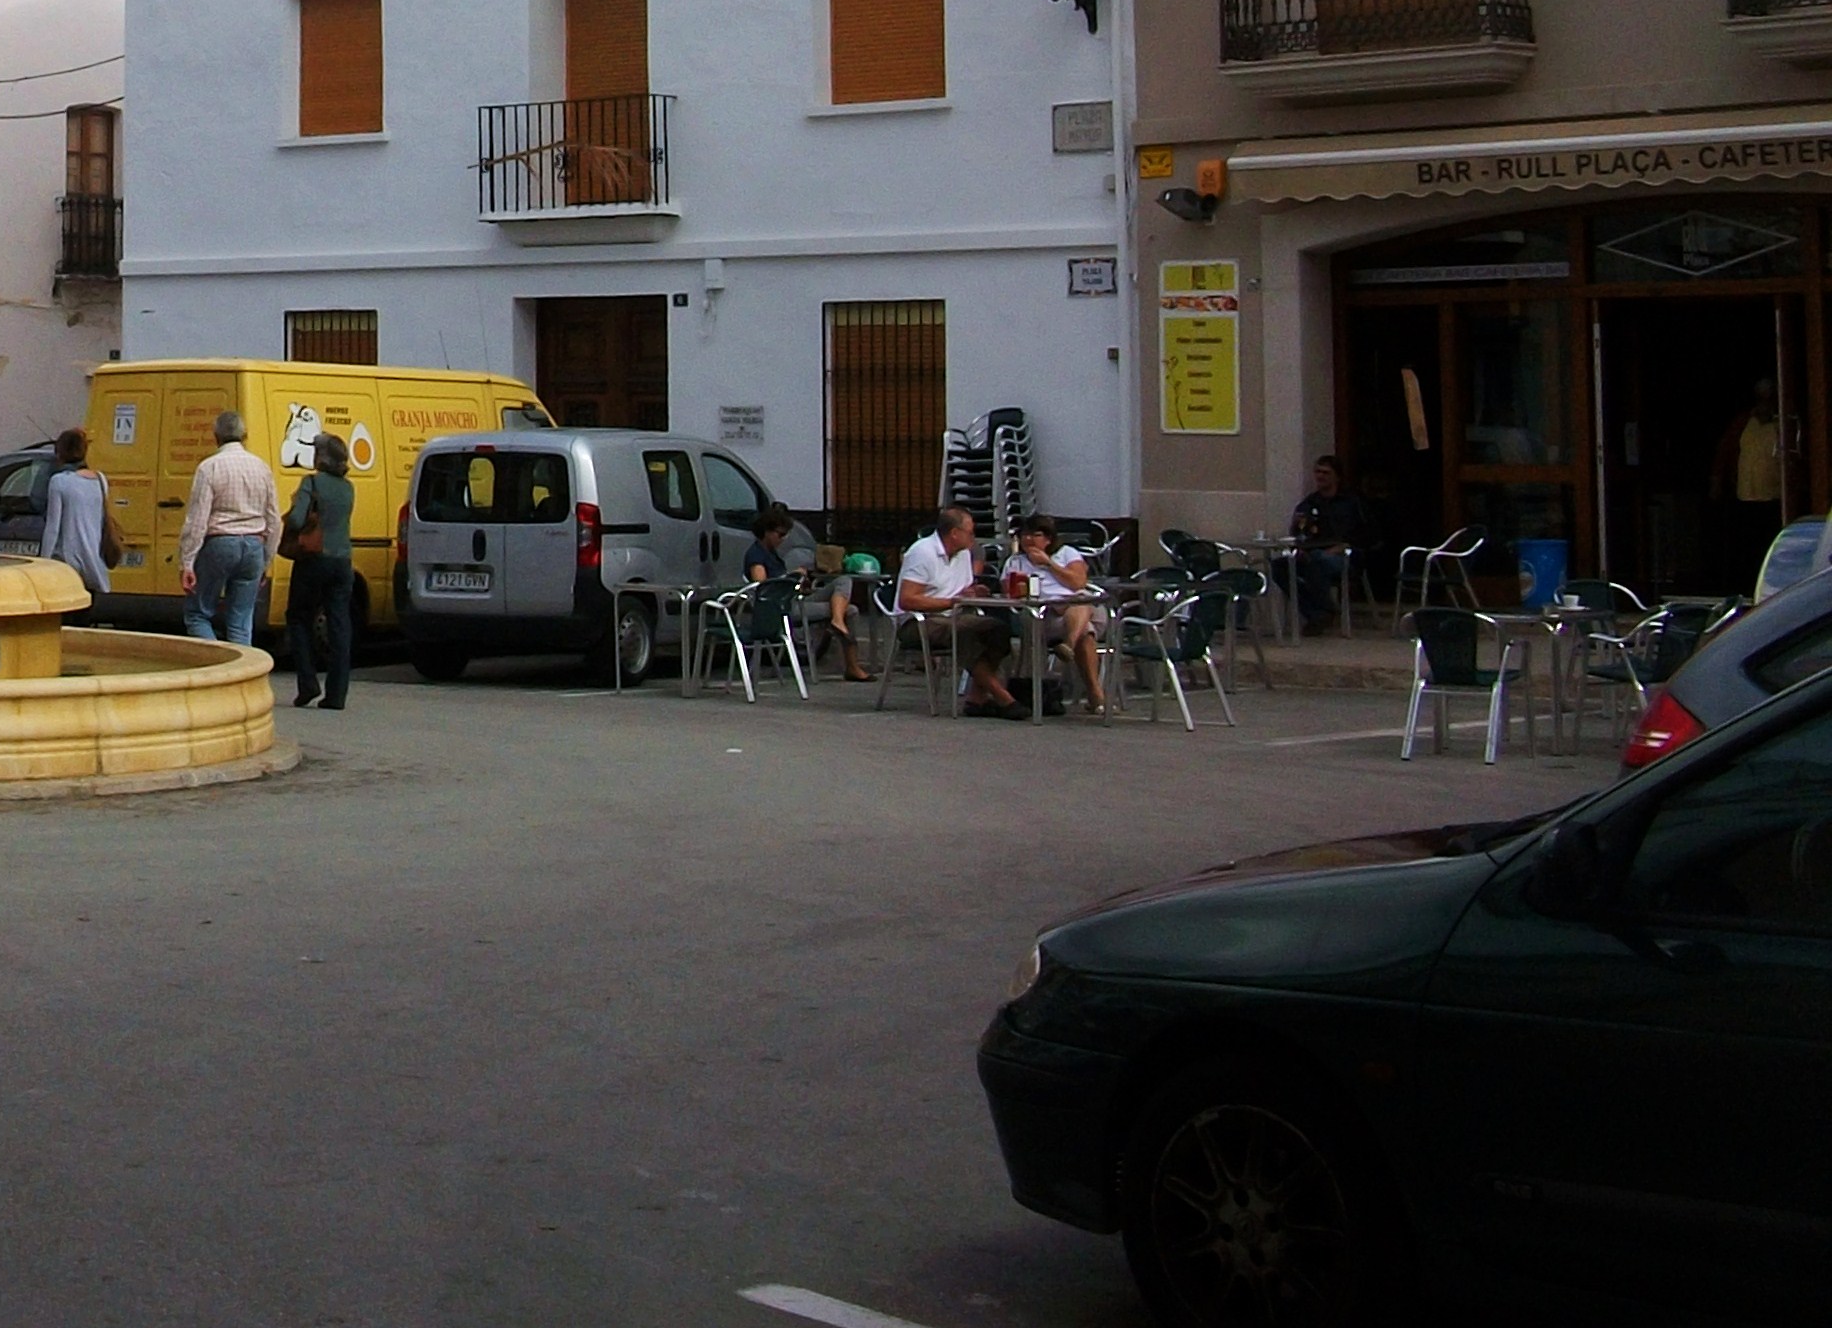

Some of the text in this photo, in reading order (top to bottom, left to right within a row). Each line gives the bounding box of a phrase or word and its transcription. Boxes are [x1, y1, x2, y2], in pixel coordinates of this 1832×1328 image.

[1417, 161, 1472, 185] BAR
[1496, 155, 1567, 180] RULL
[1576, 149, 1672, 183] PLAÇA
[392, 409, 478, 433] GRANJA MONCHO
[436, 573, 463, 584] 4121
